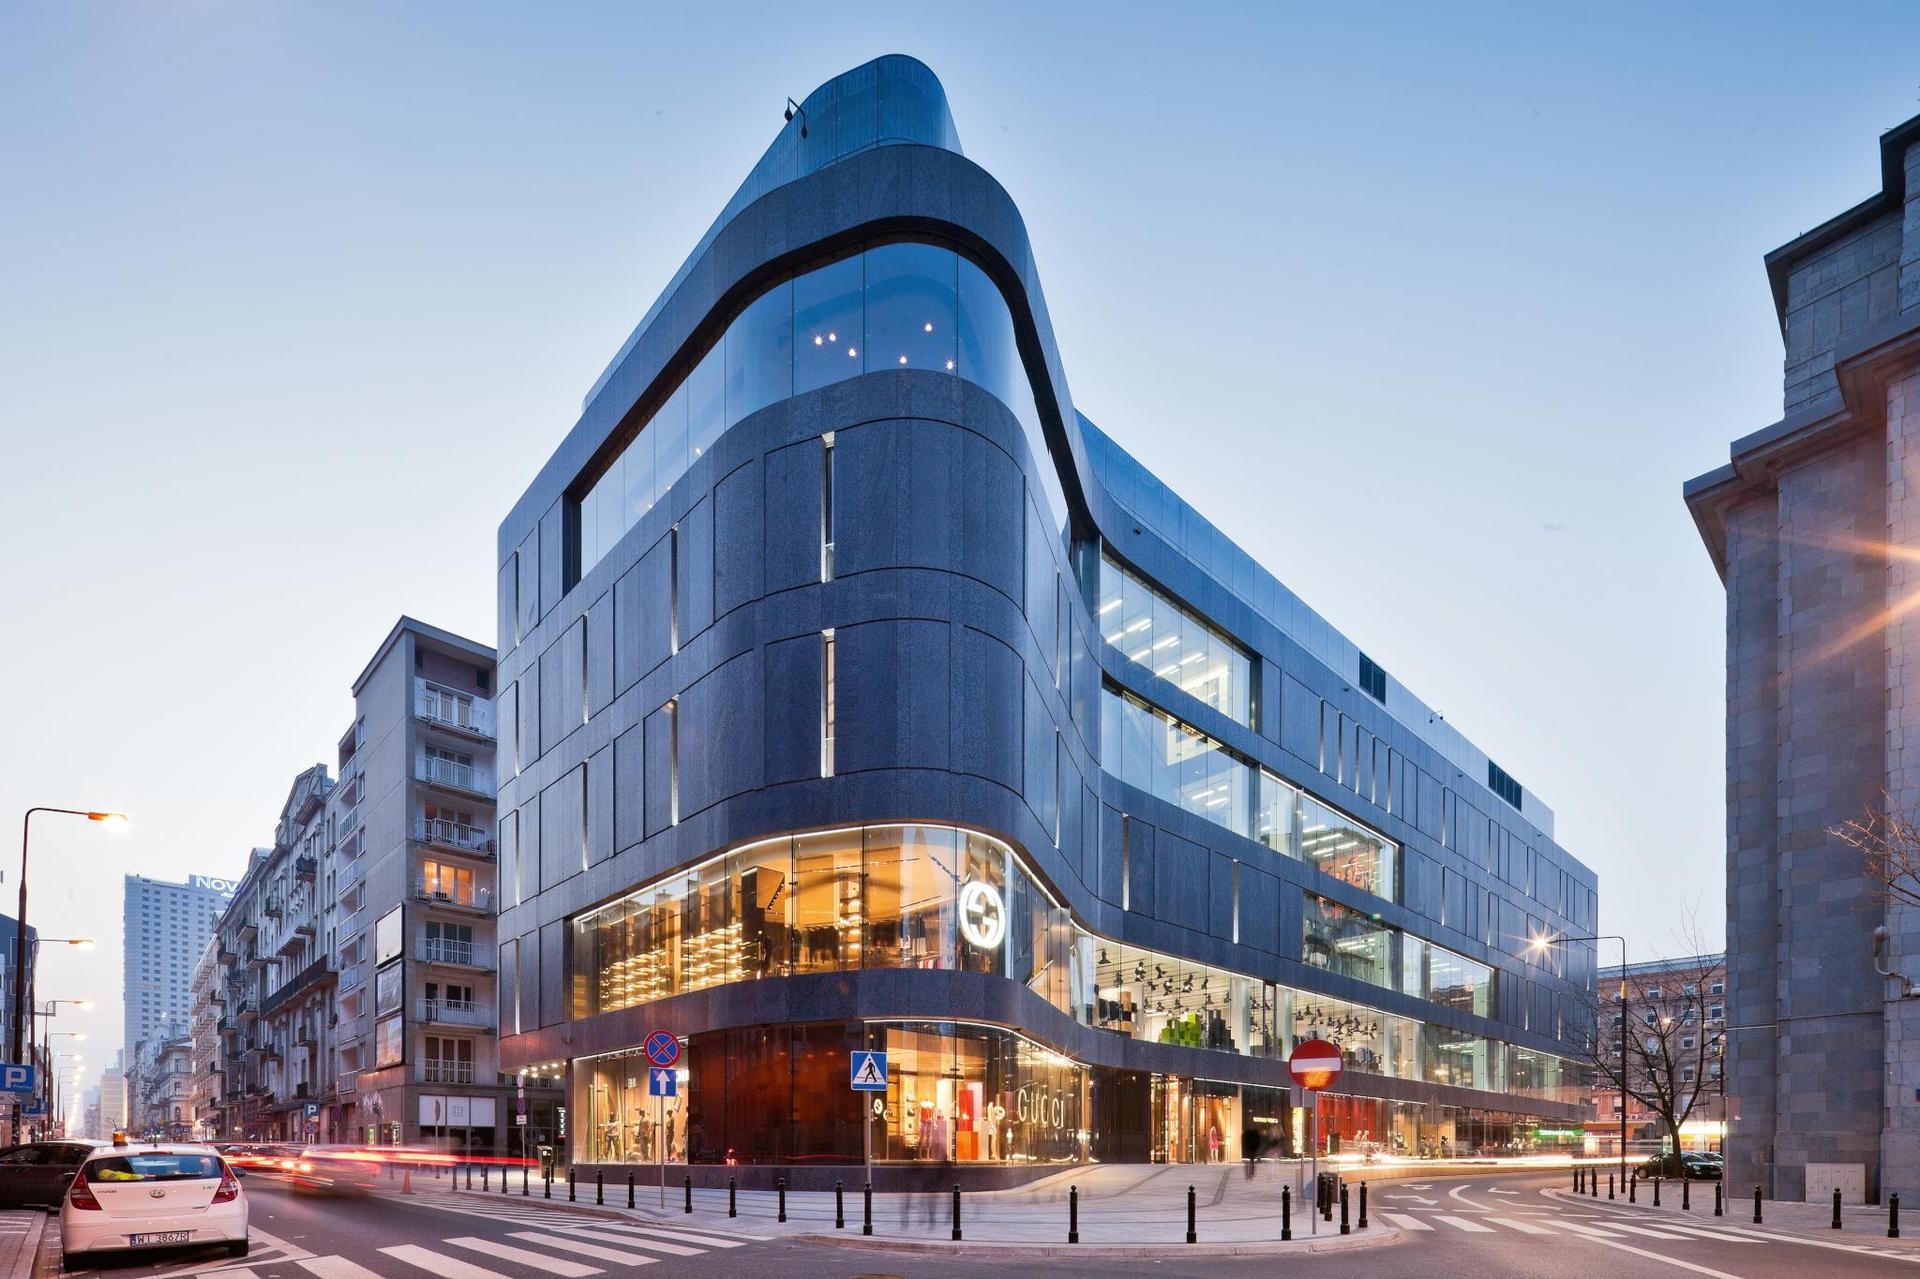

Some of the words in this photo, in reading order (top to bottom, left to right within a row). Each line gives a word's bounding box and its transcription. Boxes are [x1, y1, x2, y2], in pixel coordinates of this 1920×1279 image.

[5, 1066, 27, 1088] P
[307, 1105, 316, 1115] P
[1018, 1089, 1064, 1128] GUCCI
